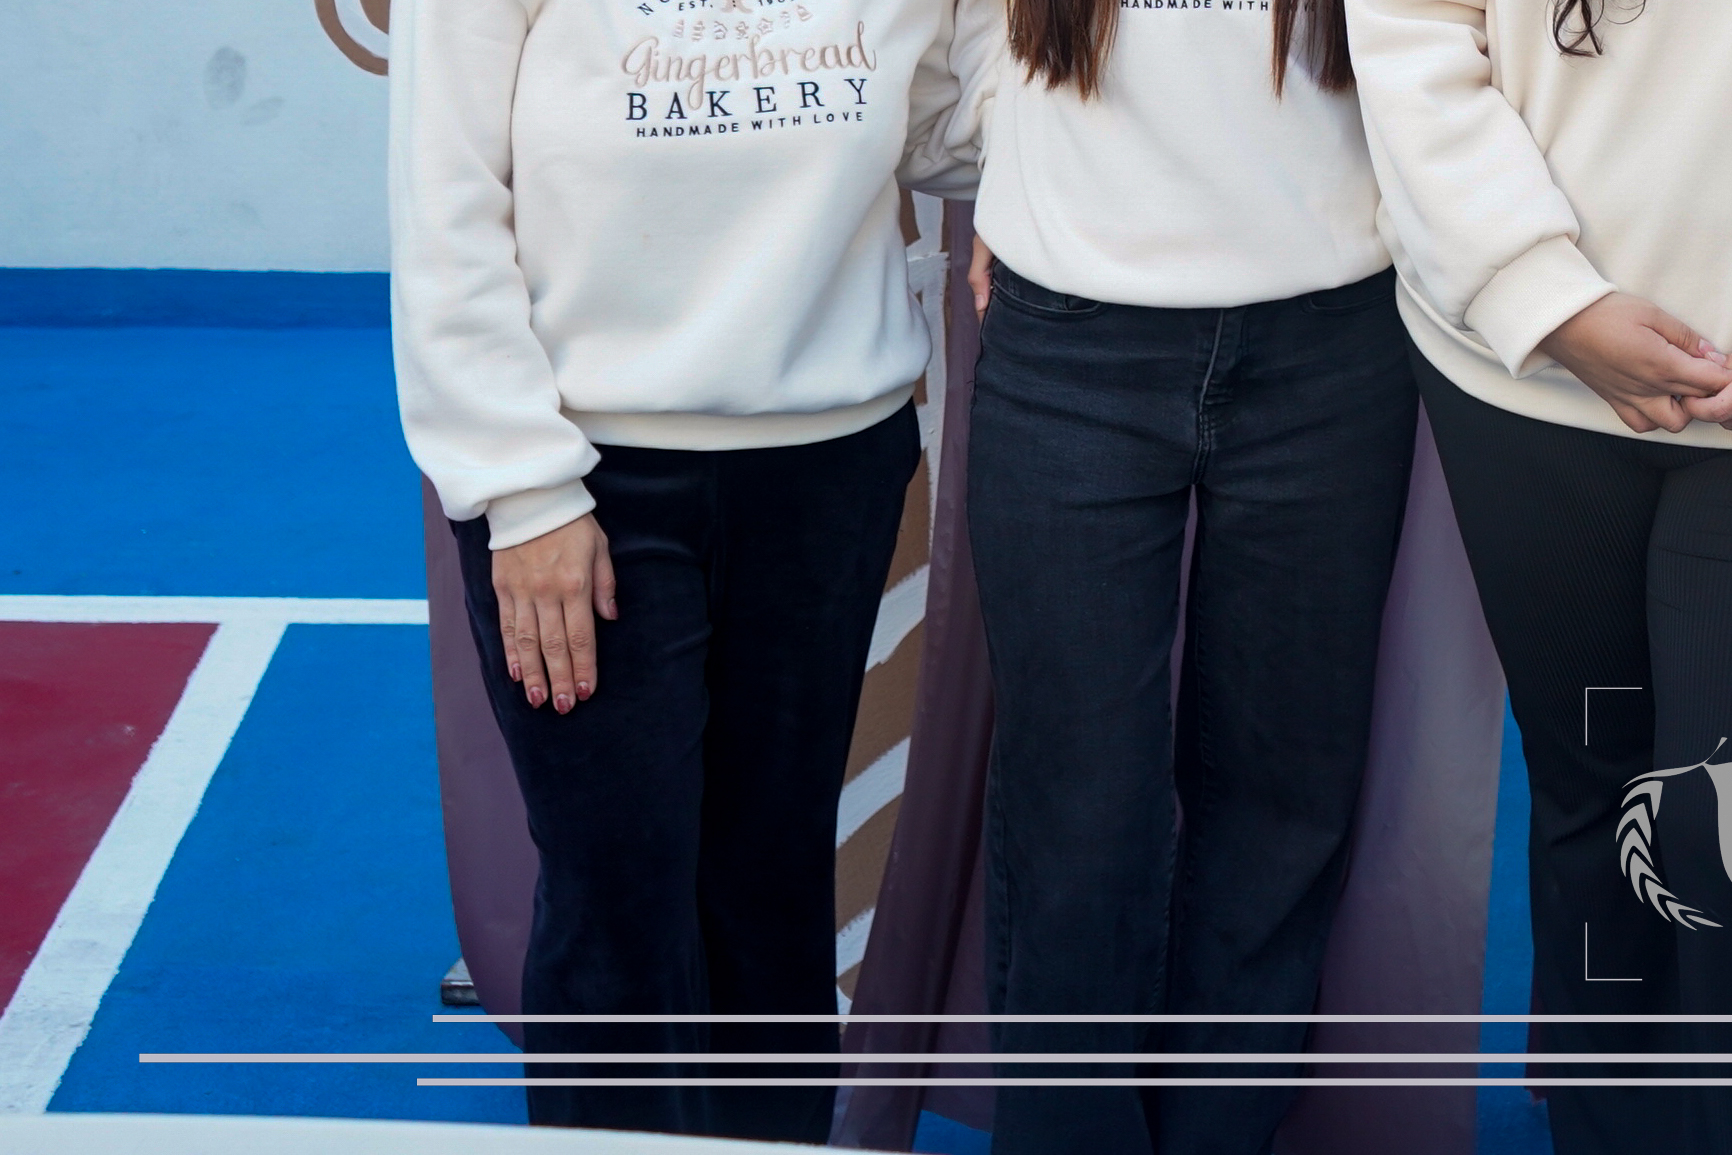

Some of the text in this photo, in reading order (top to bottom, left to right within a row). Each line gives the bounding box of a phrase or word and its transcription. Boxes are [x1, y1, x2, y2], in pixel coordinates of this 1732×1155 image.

[1222, 0, 1269, 11] WITH
[620, 19, 878, 112] Gingerbread
[625, 78, 868, 122] BAKERY
[636, 111, 864, 138] HANDMADE WITH LOVE
